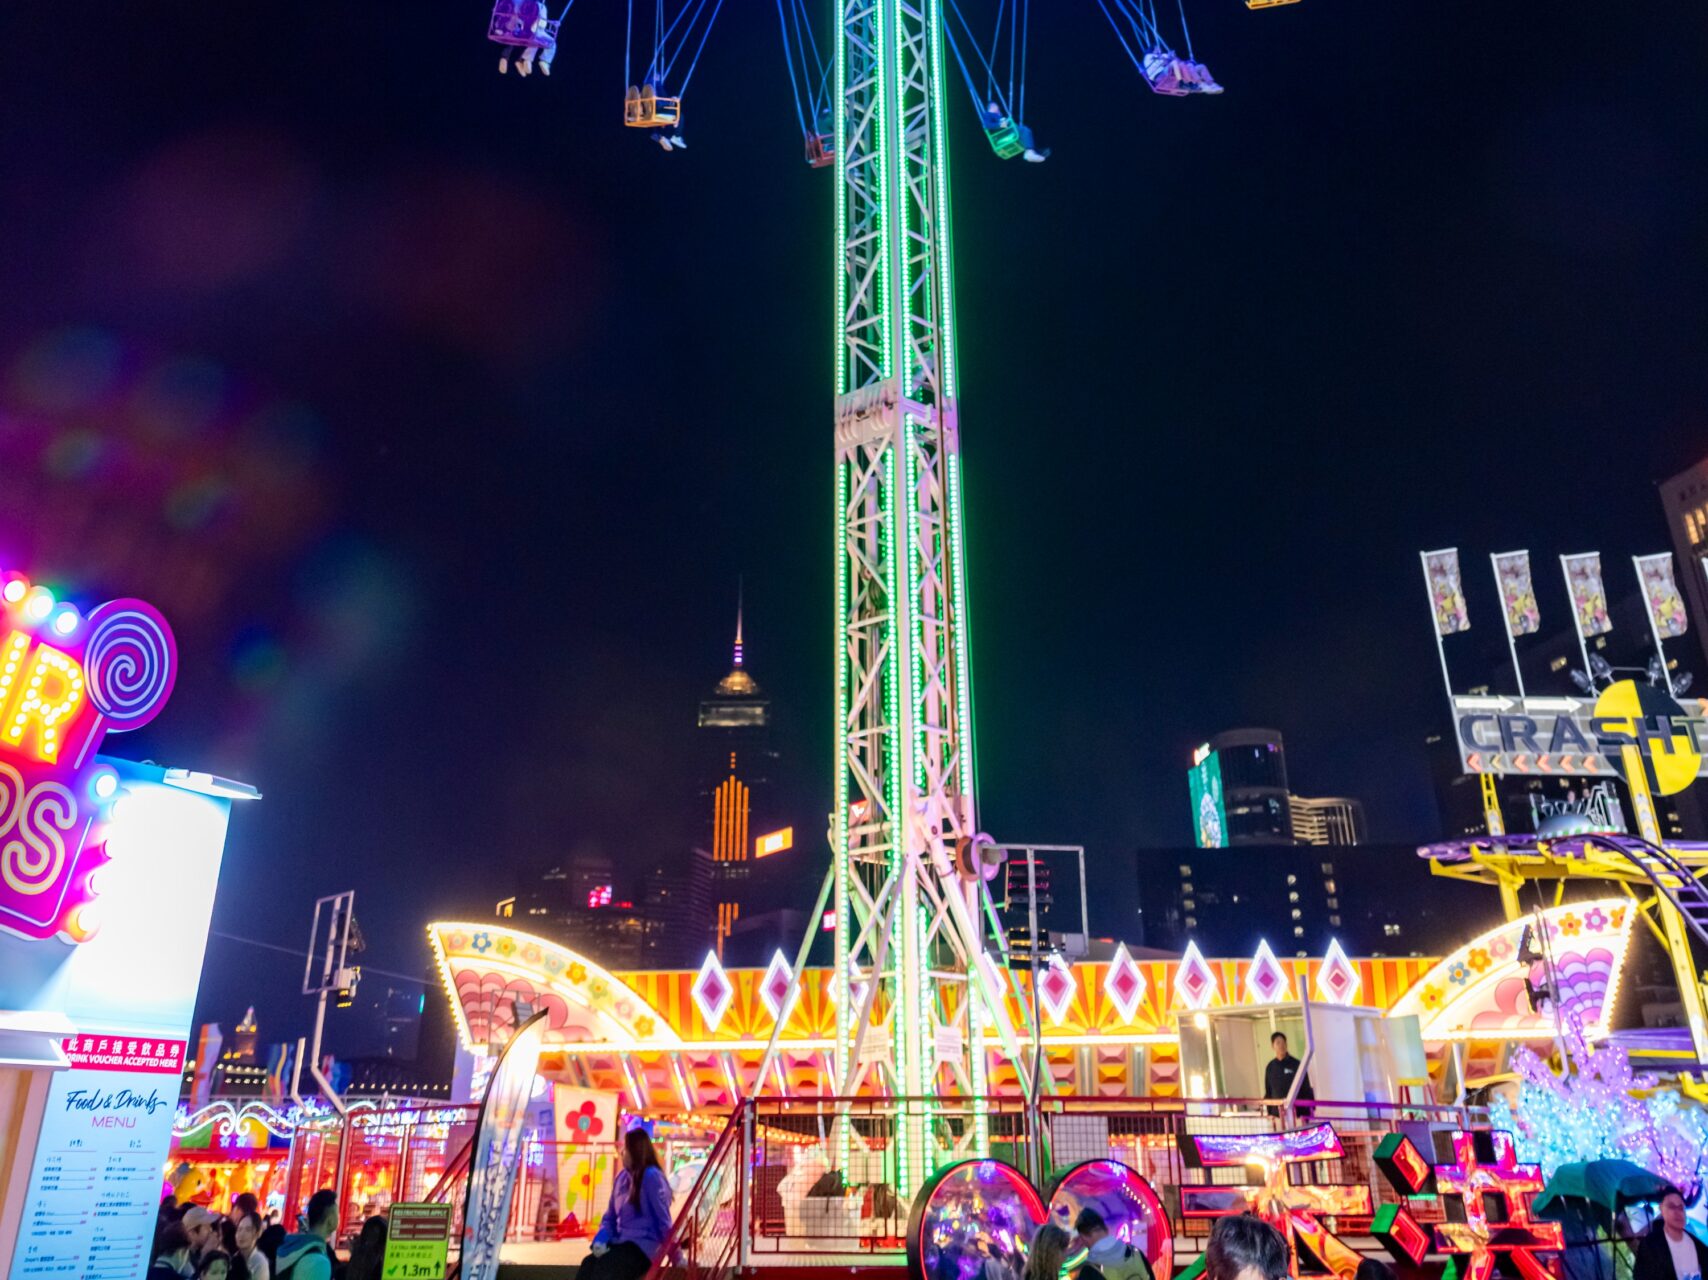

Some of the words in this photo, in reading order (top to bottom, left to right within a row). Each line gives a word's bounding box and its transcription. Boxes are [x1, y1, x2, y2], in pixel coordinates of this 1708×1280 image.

[66, 1053, 88, 1064] DRINK
[89, 1054, 124, 1066] VOUCHER
[123, 1057, 159, 1067] ACCEPTED
[159, 1059, 178, 1068] HERE
[66, 1089, 104, 1111] Food
[103, 1094, 113, 1109] &
[113, 1089, 167, 1114] Drinks
[91, 1116, 137, 1128] MENU
[401, 1264, 431, 1277] 1.3m
